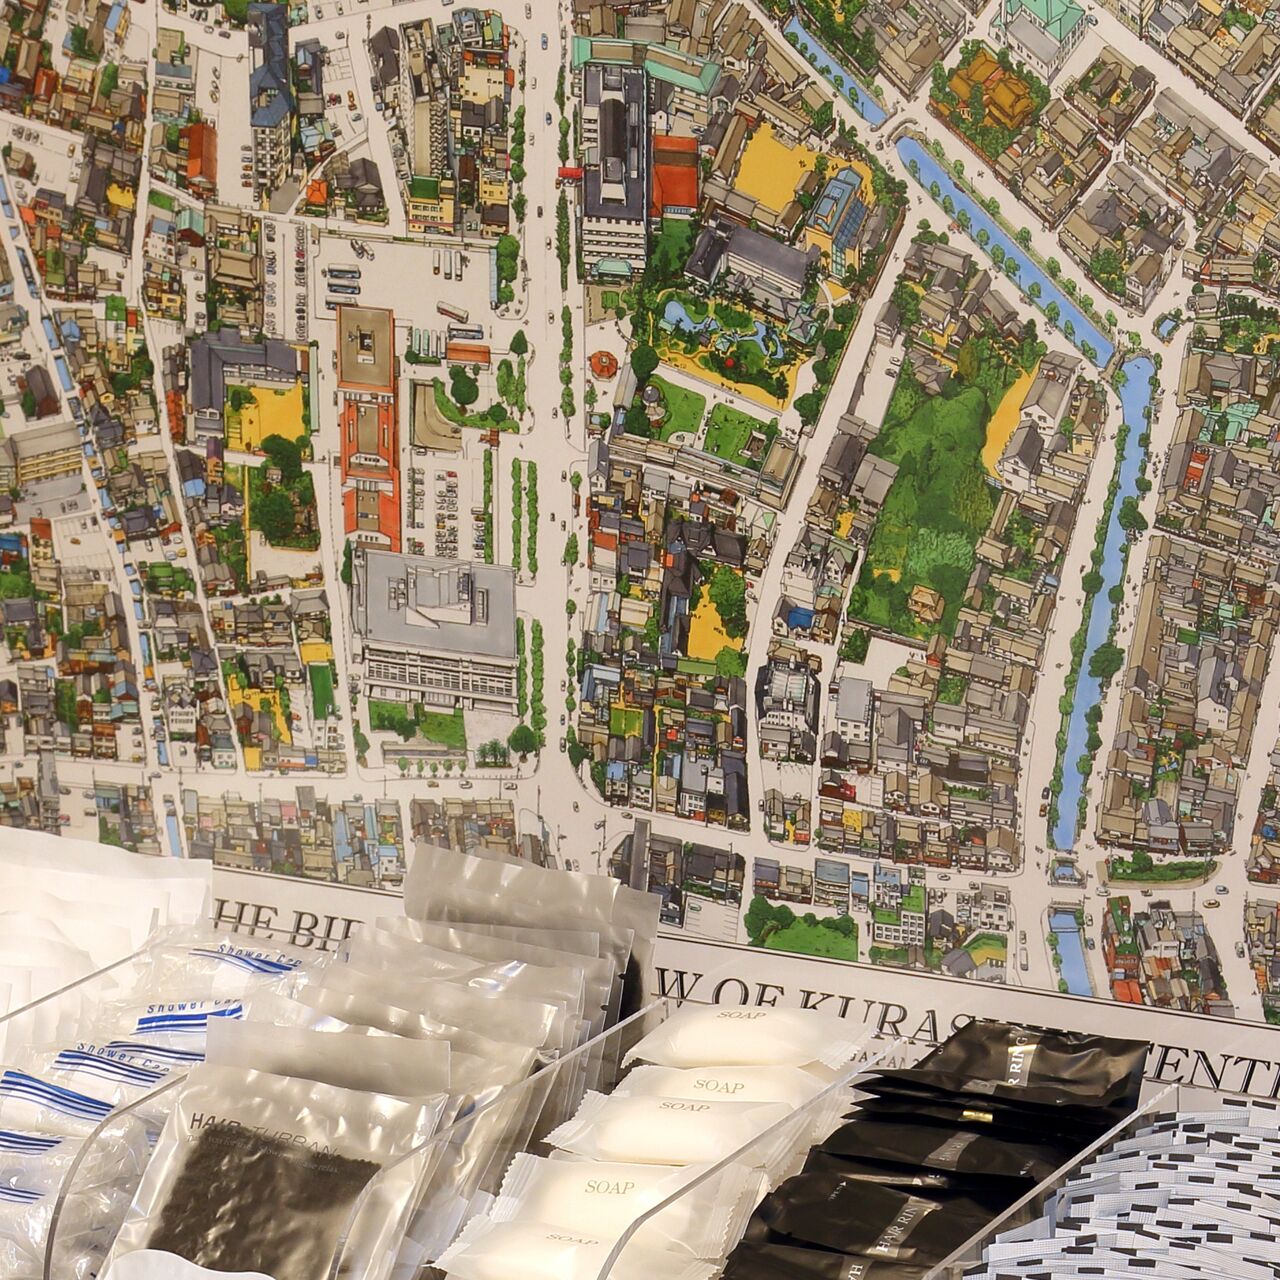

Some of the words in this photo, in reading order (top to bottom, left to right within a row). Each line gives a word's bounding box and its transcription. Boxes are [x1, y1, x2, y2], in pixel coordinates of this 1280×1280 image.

[210, 898, 279, 940] HE
[716, 1009, 768, 1021] SOAP
[693, 1078, 745, 1095] SOAP
[658, 1100, 711, 1113] SOAP
[584, 1179, 635, 1196] SOAP
[897, 1205, 919, 1225] RIN
[546, 1232, 600, 1246] SOAP
